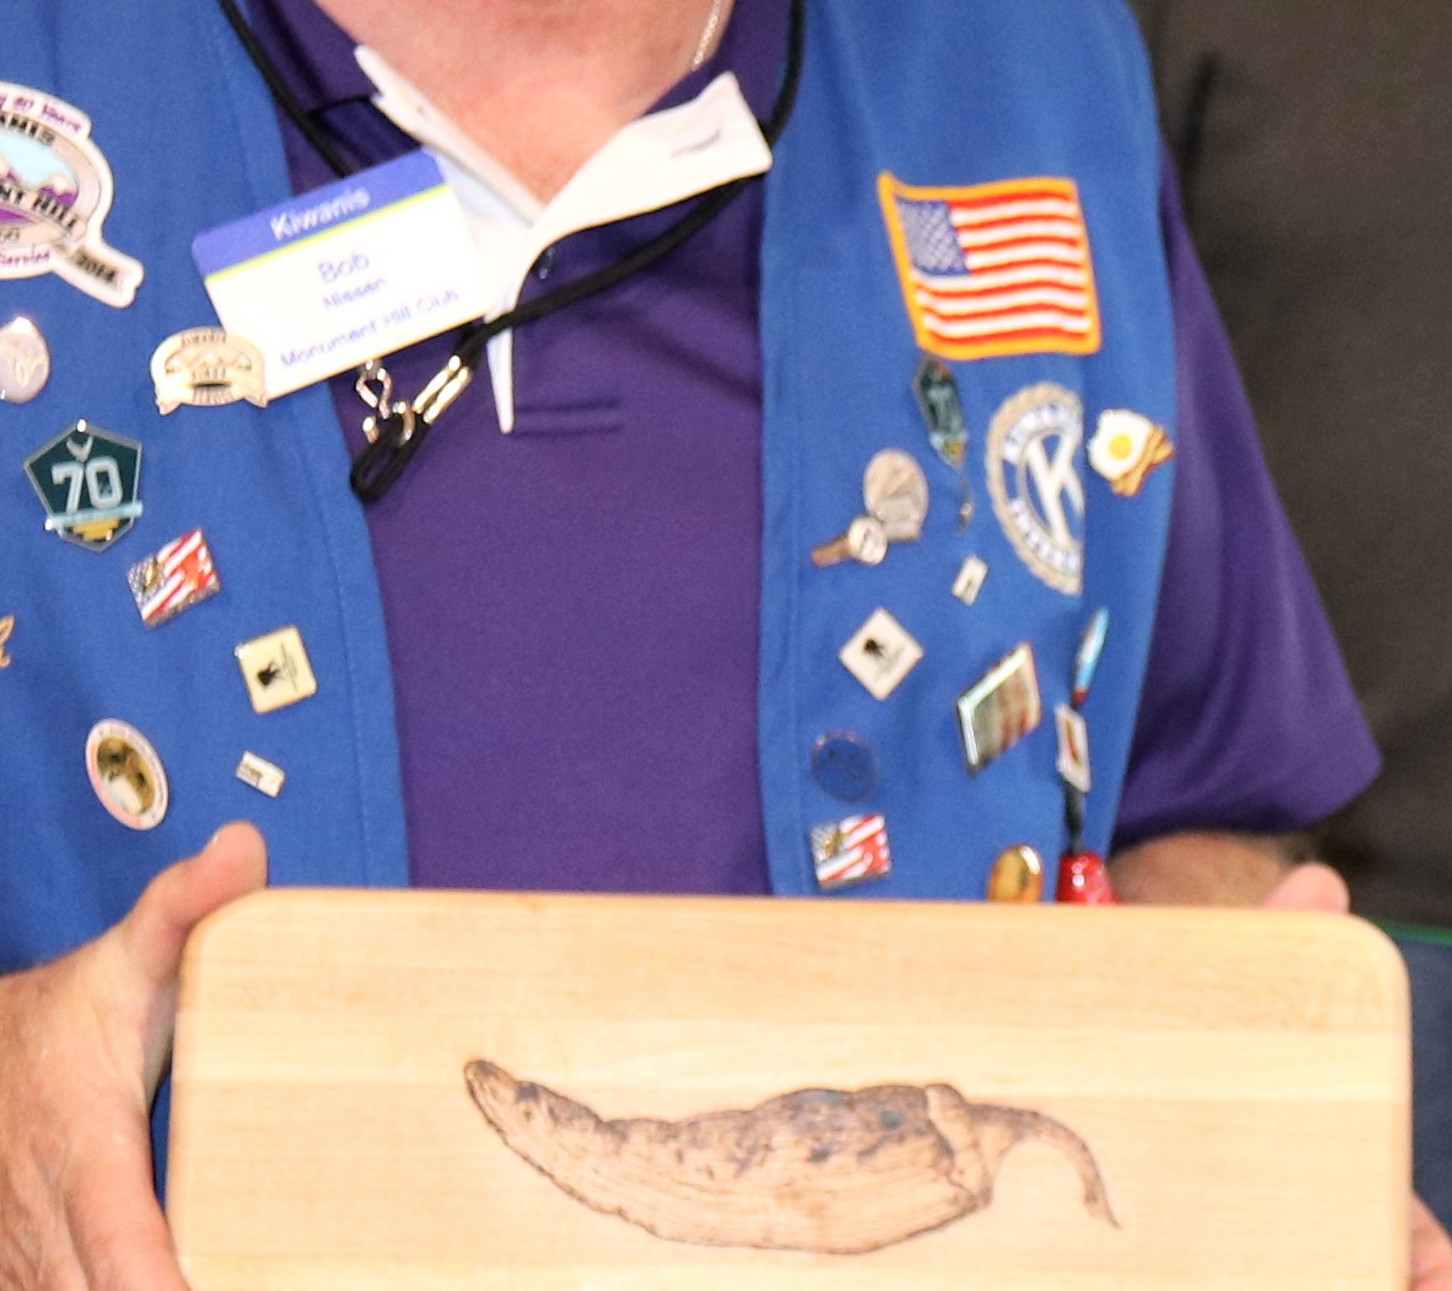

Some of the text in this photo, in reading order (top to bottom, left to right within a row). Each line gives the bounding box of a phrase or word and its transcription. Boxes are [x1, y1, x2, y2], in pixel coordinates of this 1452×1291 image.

[32, 197, 77, 230] HILL
[270, 186, 371, 240] Kiwanis
[317, 253, 369, 285] Bob
[280, 287, 460, 369] Monument Hill Club
[51, 455, 124, 514] 70
